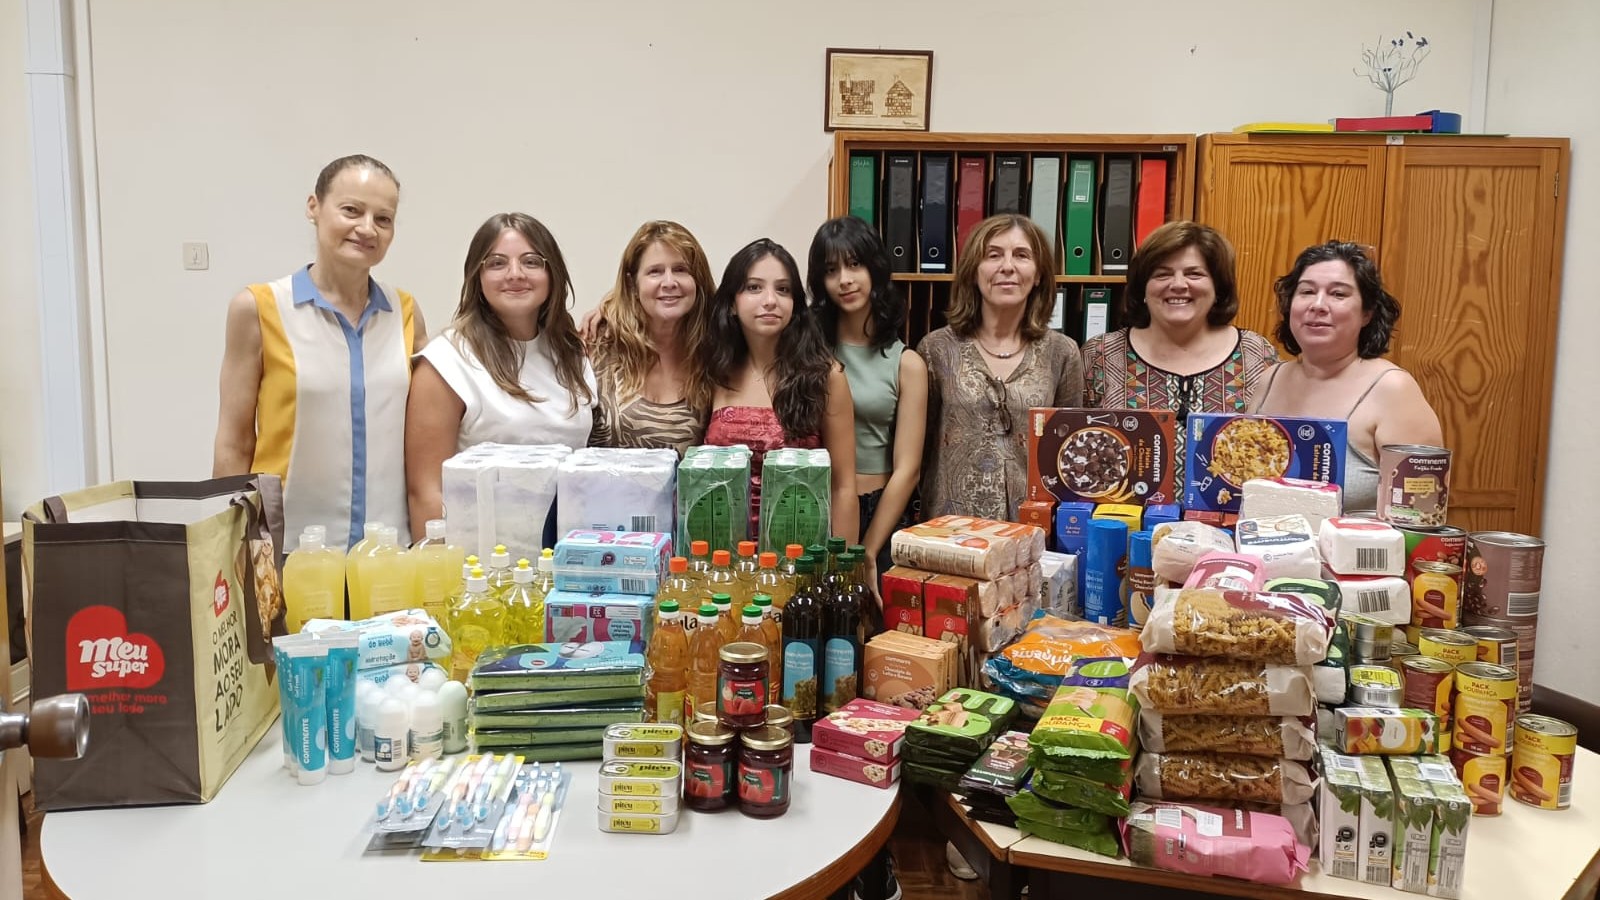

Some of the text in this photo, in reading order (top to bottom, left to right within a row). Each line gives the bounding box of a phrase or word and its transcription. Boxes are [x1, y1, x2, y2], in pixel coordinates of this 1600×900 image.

[1322, 443, 1331, 483] CONTINE
[78, 636, 148, 663] Meu
[212, 610, 238, 645] O MELHOR
[91, 659, 149, 678] super
[213, 631, 241, 676] MORA
[215, 656, 244, 702] AO SEU
[215, 684, 243, 733] LADO
[332, 708, 340, 753] CONTINENTE
[302, 718, 310, 764] CONTINENTE
